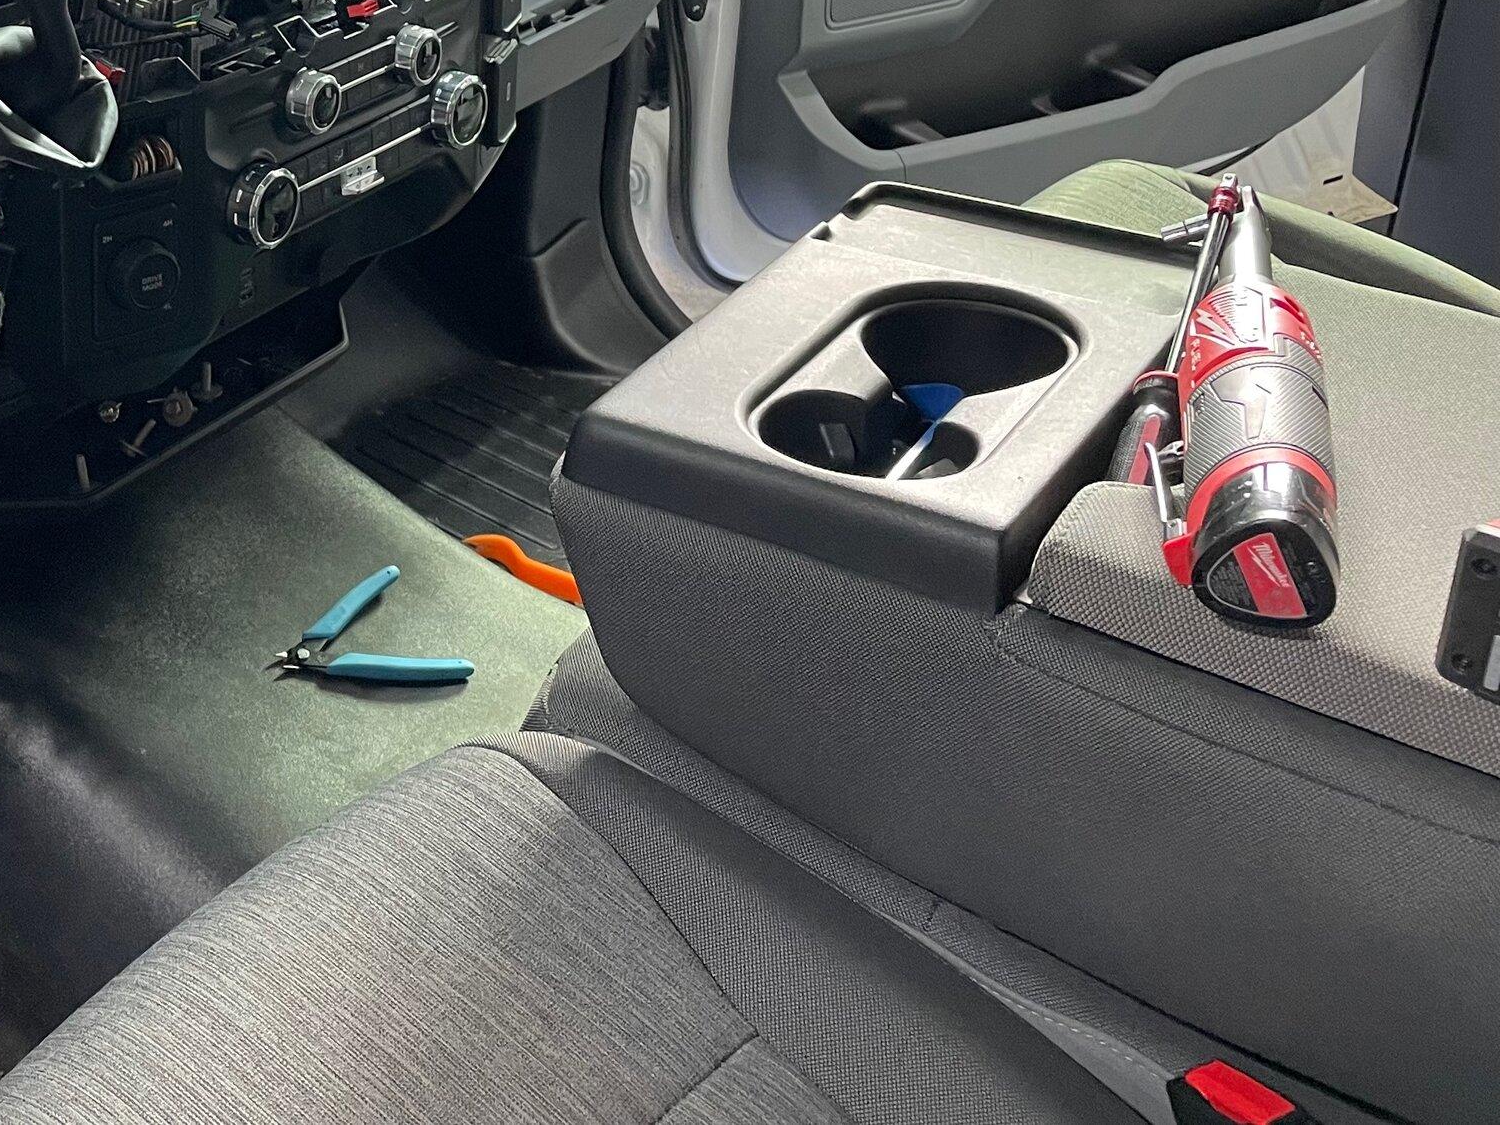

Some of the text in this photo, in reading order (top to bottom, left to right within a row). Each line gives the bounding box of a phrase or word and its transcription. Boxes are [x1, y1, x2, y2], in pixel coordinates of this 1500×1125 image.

[141, 274, 163, 285] DRIVE
[141, 281, 163, 292] MODE
[1251, 541, 1292, 588] Milwaukee
